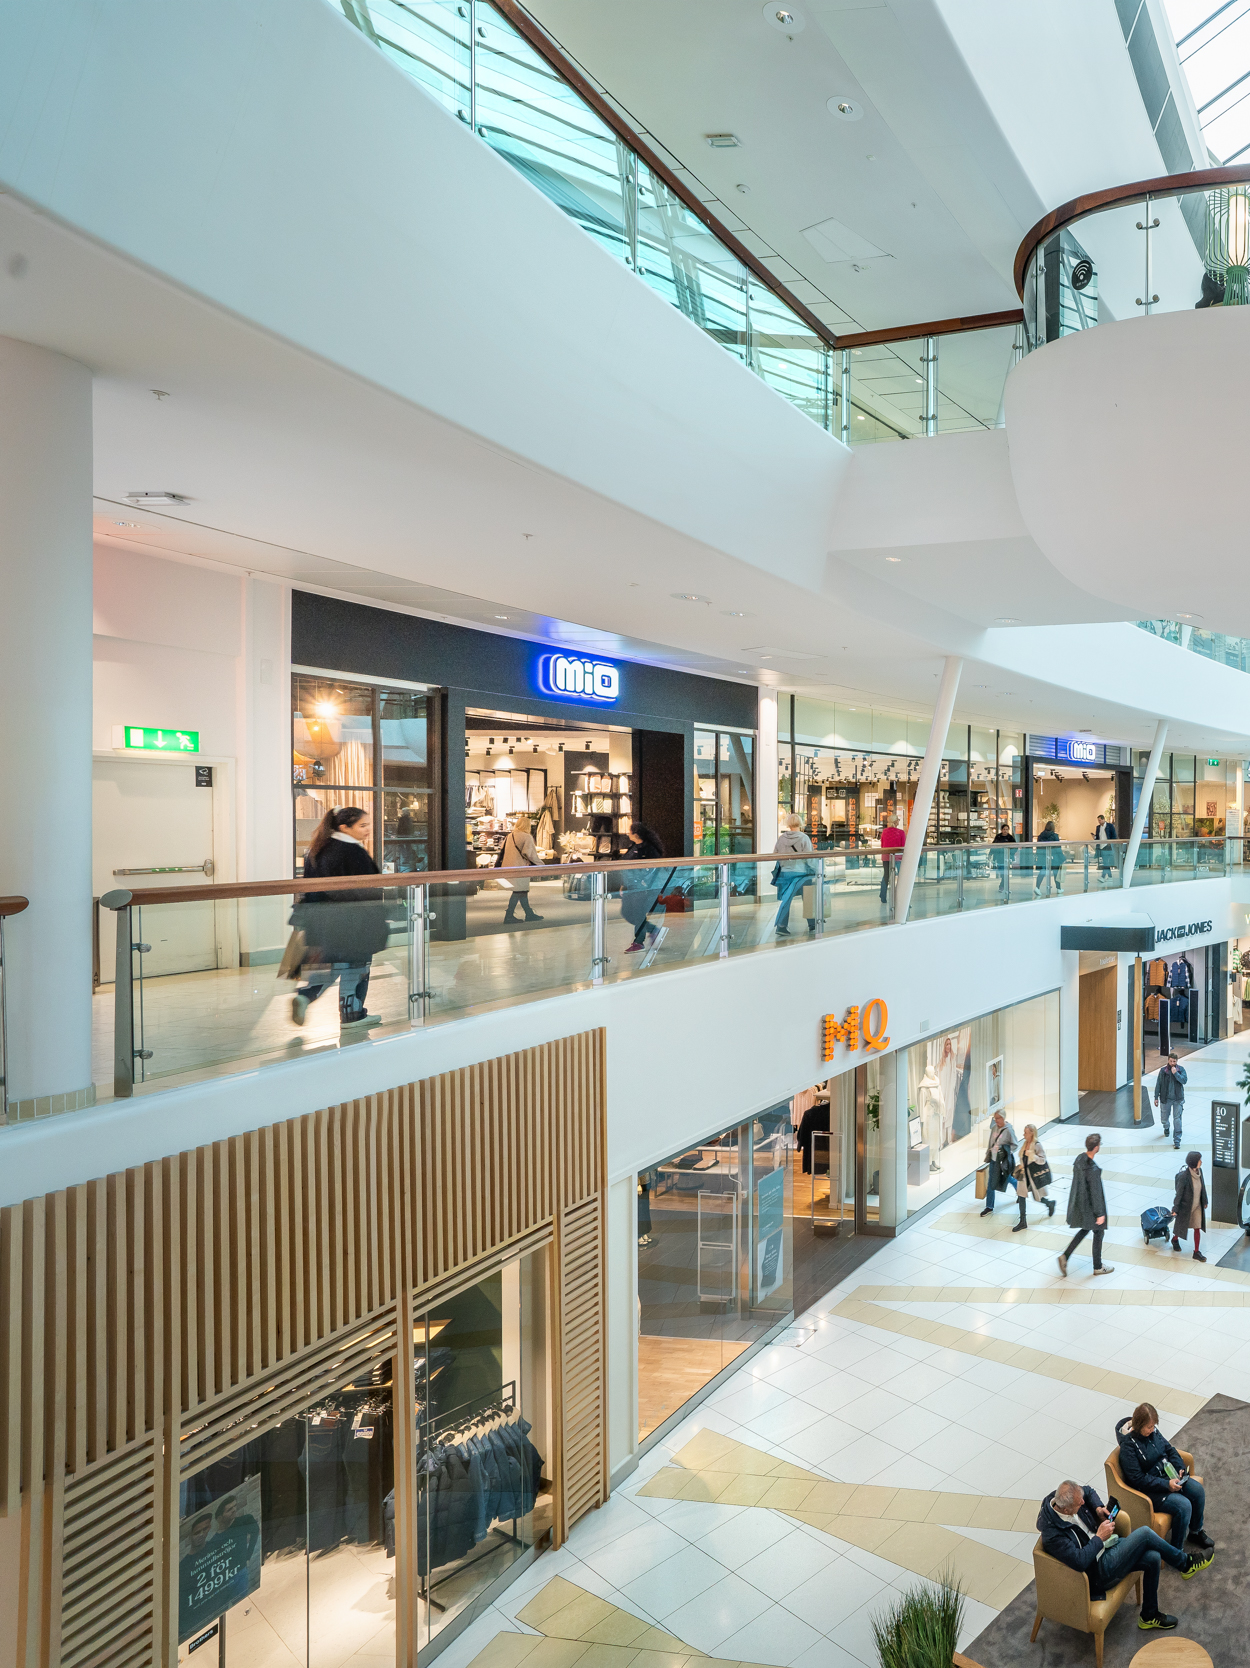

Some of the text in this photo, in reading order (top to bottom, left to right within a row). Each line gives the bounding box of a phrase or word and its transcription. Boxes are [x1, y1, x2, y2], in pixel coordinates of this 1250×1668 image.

[1155, 928, 1177, 944] JACK
[1185, 920, 1213, 937] JONES
[822, 998, 891, 1062] MQ
[187, 1574, 224, 1607] 1499
[225, 1564, 241, 1581] kr
[196, 1556, 233, 1588] 2 för
